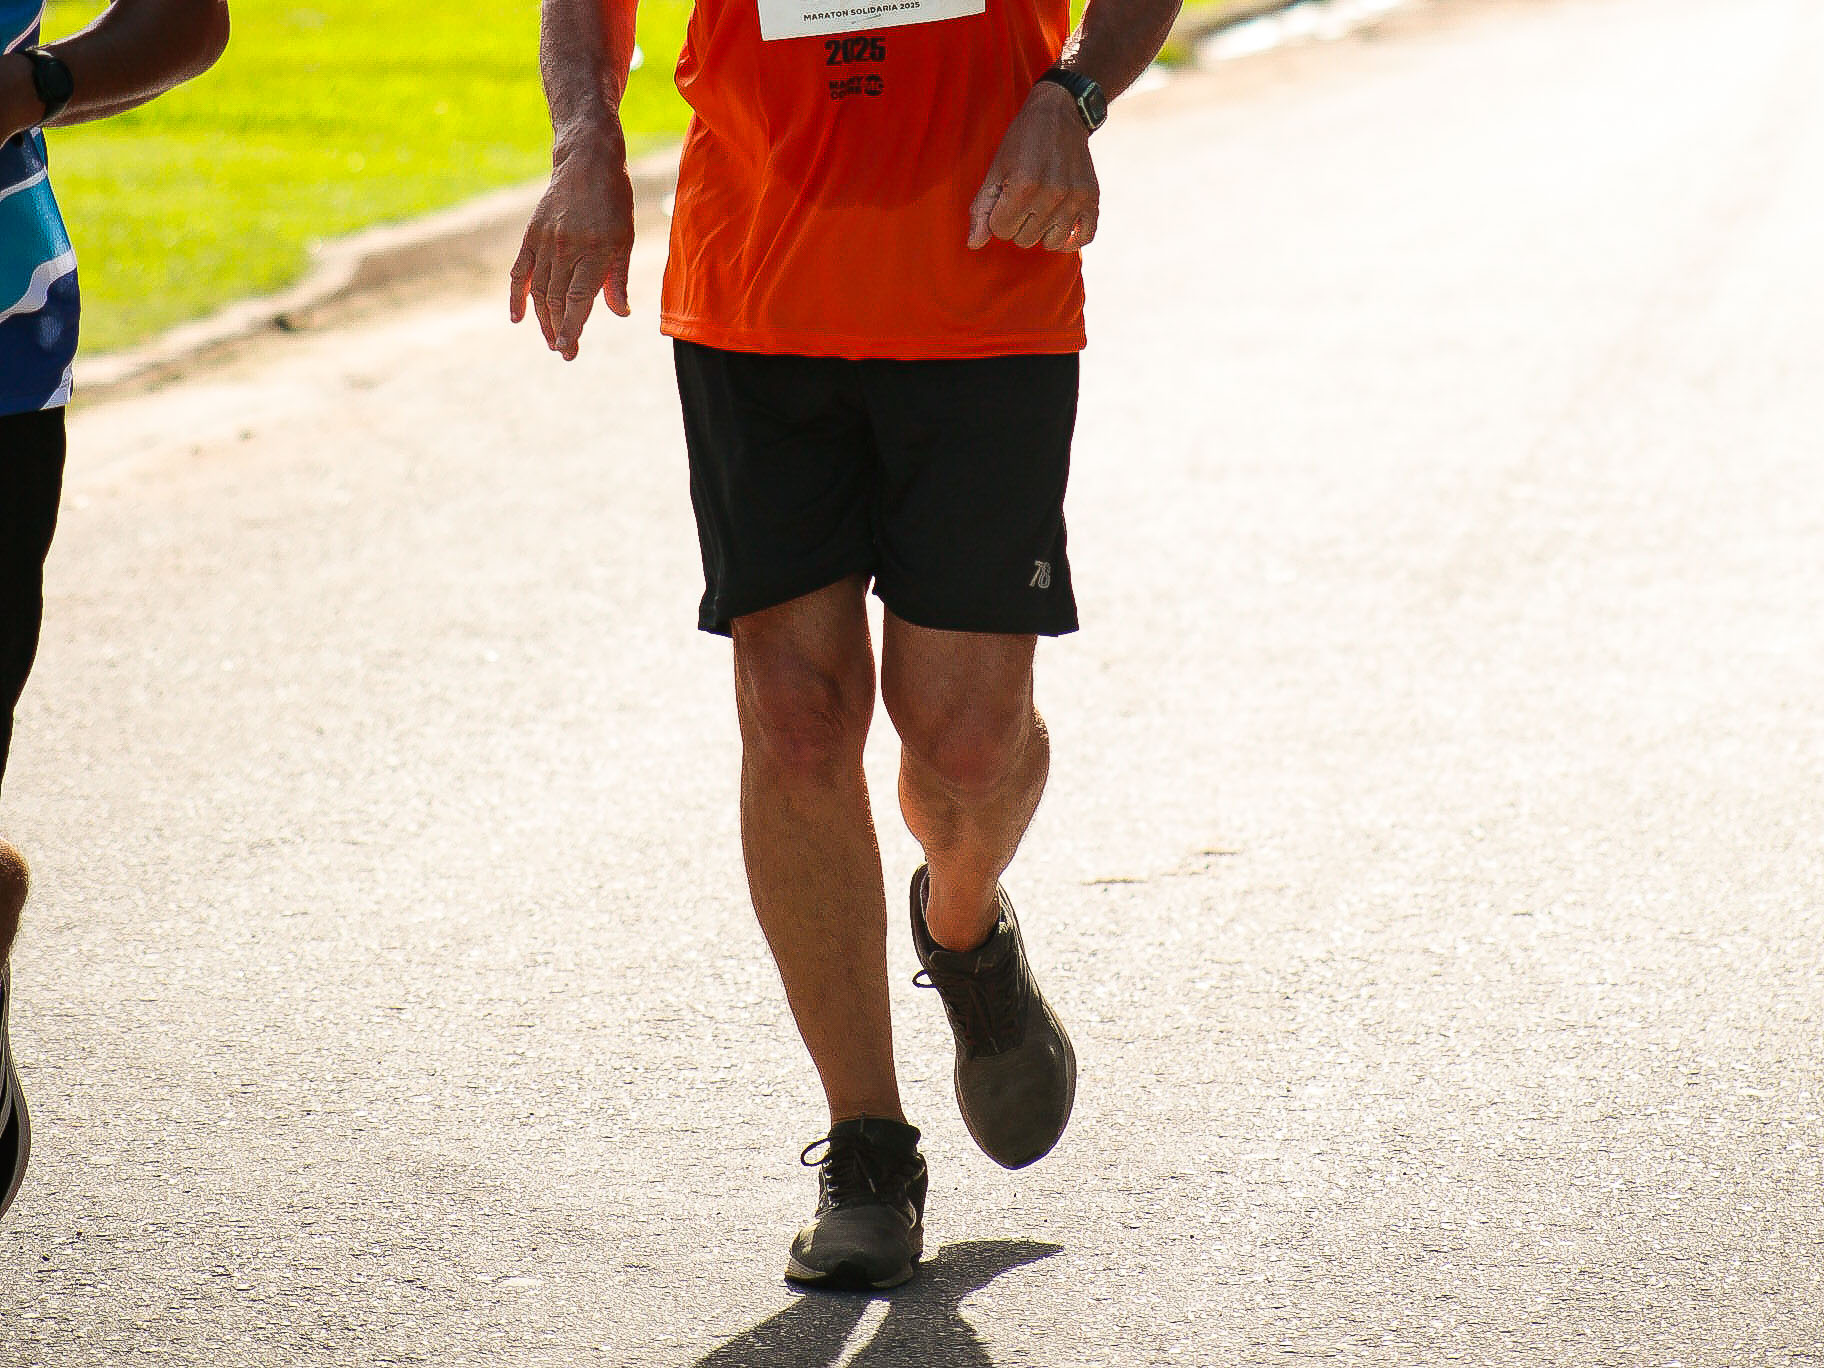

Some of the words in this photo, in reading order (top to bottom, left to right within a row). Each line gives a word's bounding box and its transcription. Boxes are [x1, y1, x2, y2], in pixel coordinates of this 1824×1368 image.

[803, 9, 848, 22] MARATON
[850, 4, 898, 16] SOLIDARIA
[899, 1, 921, 10] 2025
[825, 37, 886, 65] 2025
